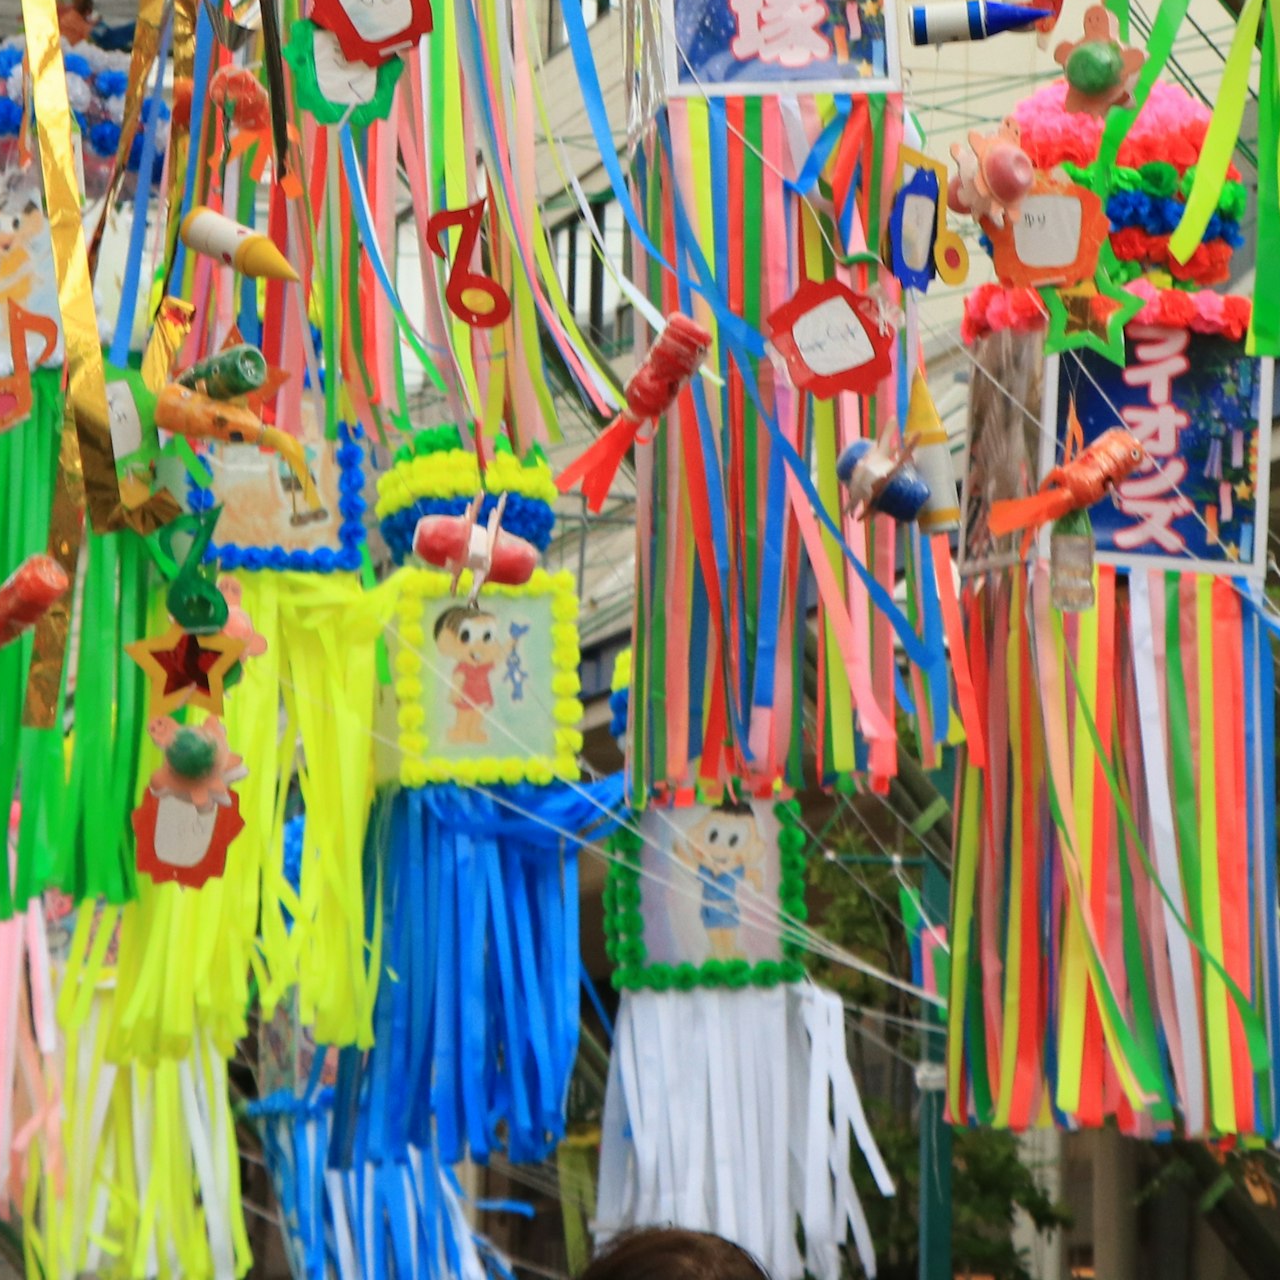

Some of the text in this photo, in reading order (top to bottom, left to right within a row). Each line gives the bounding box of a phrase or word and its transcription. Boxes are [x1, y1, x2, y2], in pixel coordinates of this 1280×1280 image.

[1112, 324, 1194, 555] ライオンズ
